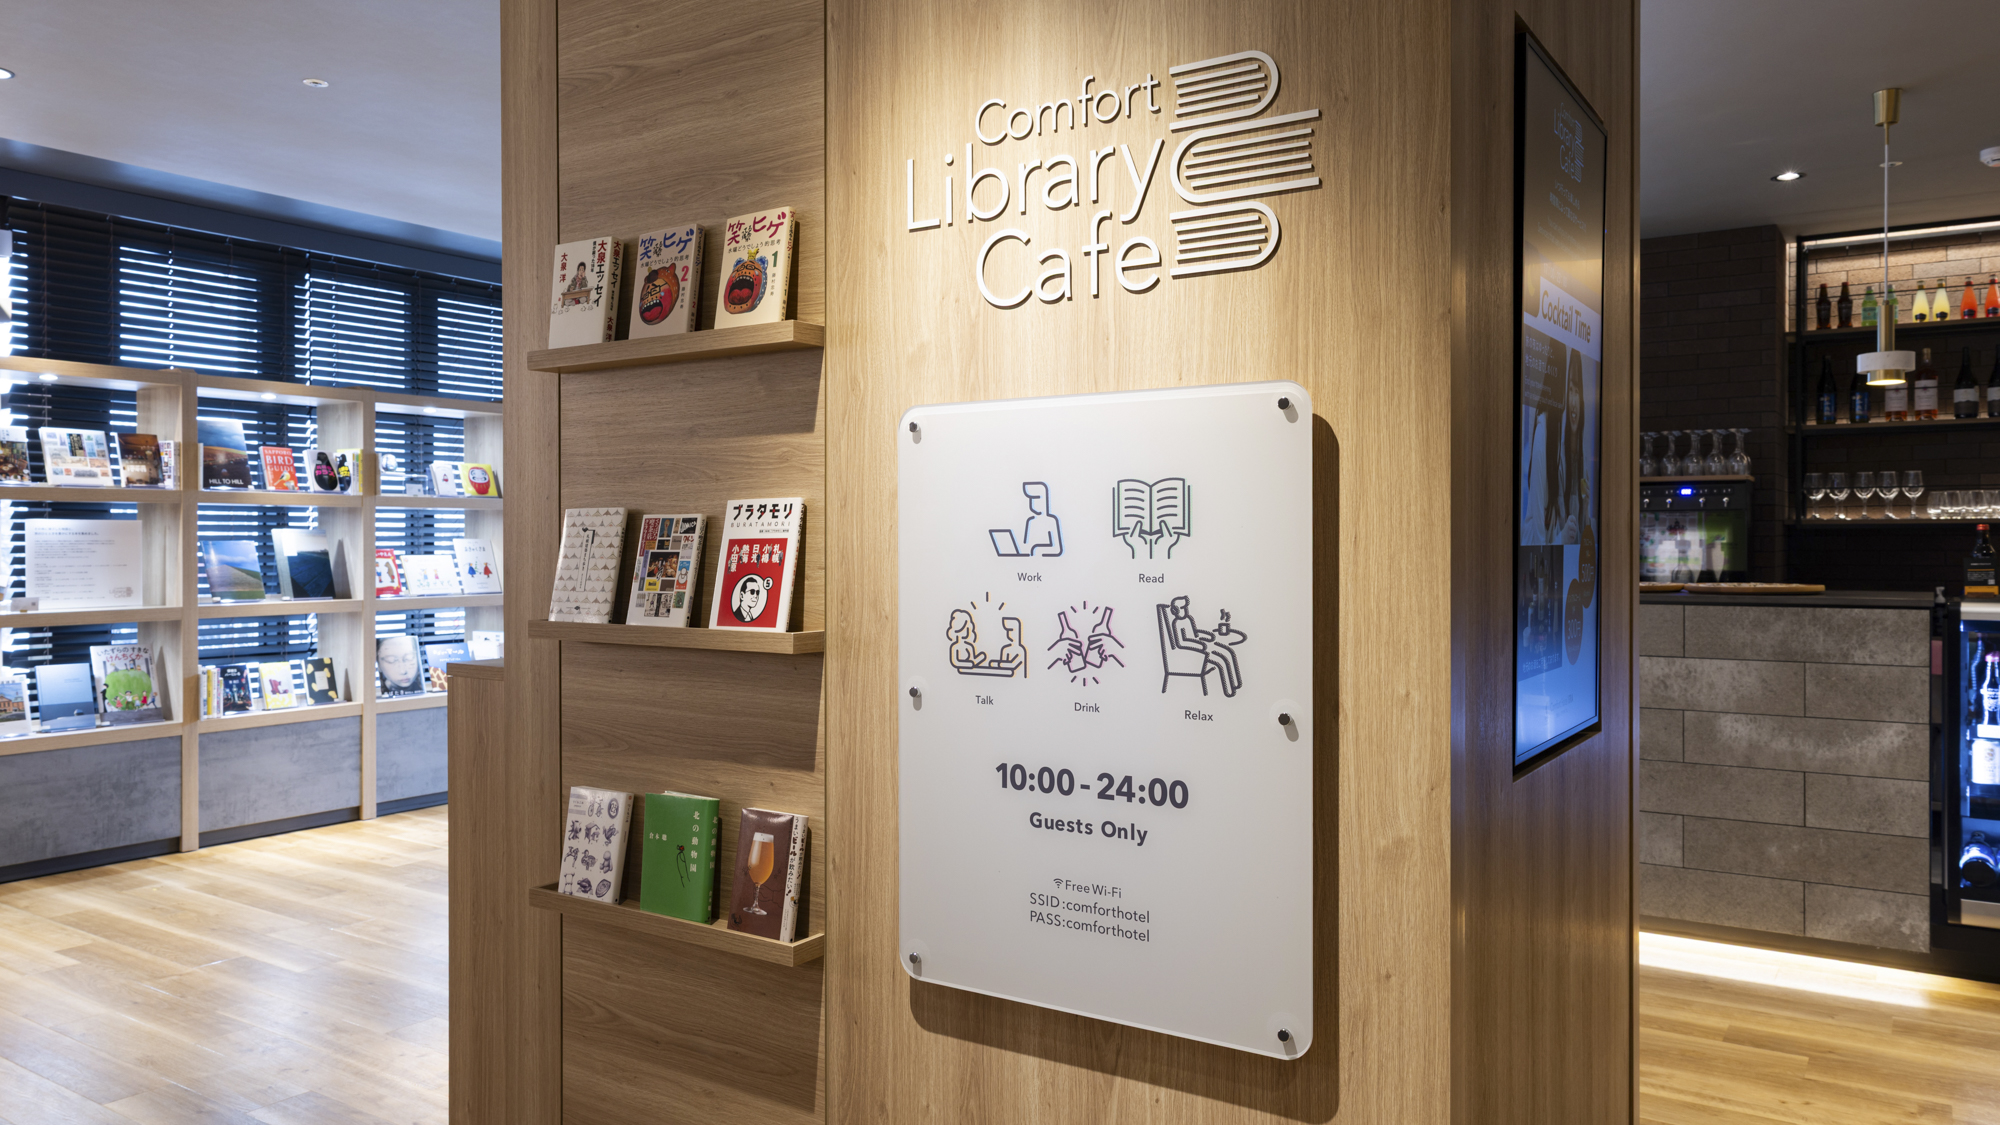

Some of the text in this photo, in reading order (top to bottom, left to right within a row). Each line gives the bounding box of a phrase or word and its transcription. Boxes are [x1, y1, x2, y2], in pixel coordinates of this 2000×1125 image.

[975, 73, 1161, 146] Comfort
[1559, 144, 1575, 179] Cafe
[907, 138, 1164, 231] Library
[728, 239, 781, 254] 水曜どうでしょう的思考
[610, 241, 622, 289] 大泉エッセイ
[640, 254, 690, 268] 水曜どうでしょう的思考
[772, 250, 779, 268] 1
[976, 210, 1162, 309] Cafe
[594, 240, 608, 307] 大泉エッセイ
[681, 265, 690, 282] 2
[1541, 290, 1592, 344] Cocktail Time
[266, 455, 294, 465] BIRD
[267, 464, 294, 472] GUIDE
[733, 503, 793, 520] ブラタモリ
[751, 544, 760, 563] 日光
[1017, 572, 1042, 582] Work
[1138, 573, 1165, 584] Read
[975, 695, 994, 705] Talk
[1074, 702, 1100, 713] Drink
[1184, 710, 1214, 722] Relax
[1029, 812, 1148, 847] Guests Only
[689, 811, 700, 873] 北の動物園
[709, 816, 718, 869] 北の動物園
[1065, 880, 1122, 898] Free Wi-Fi
